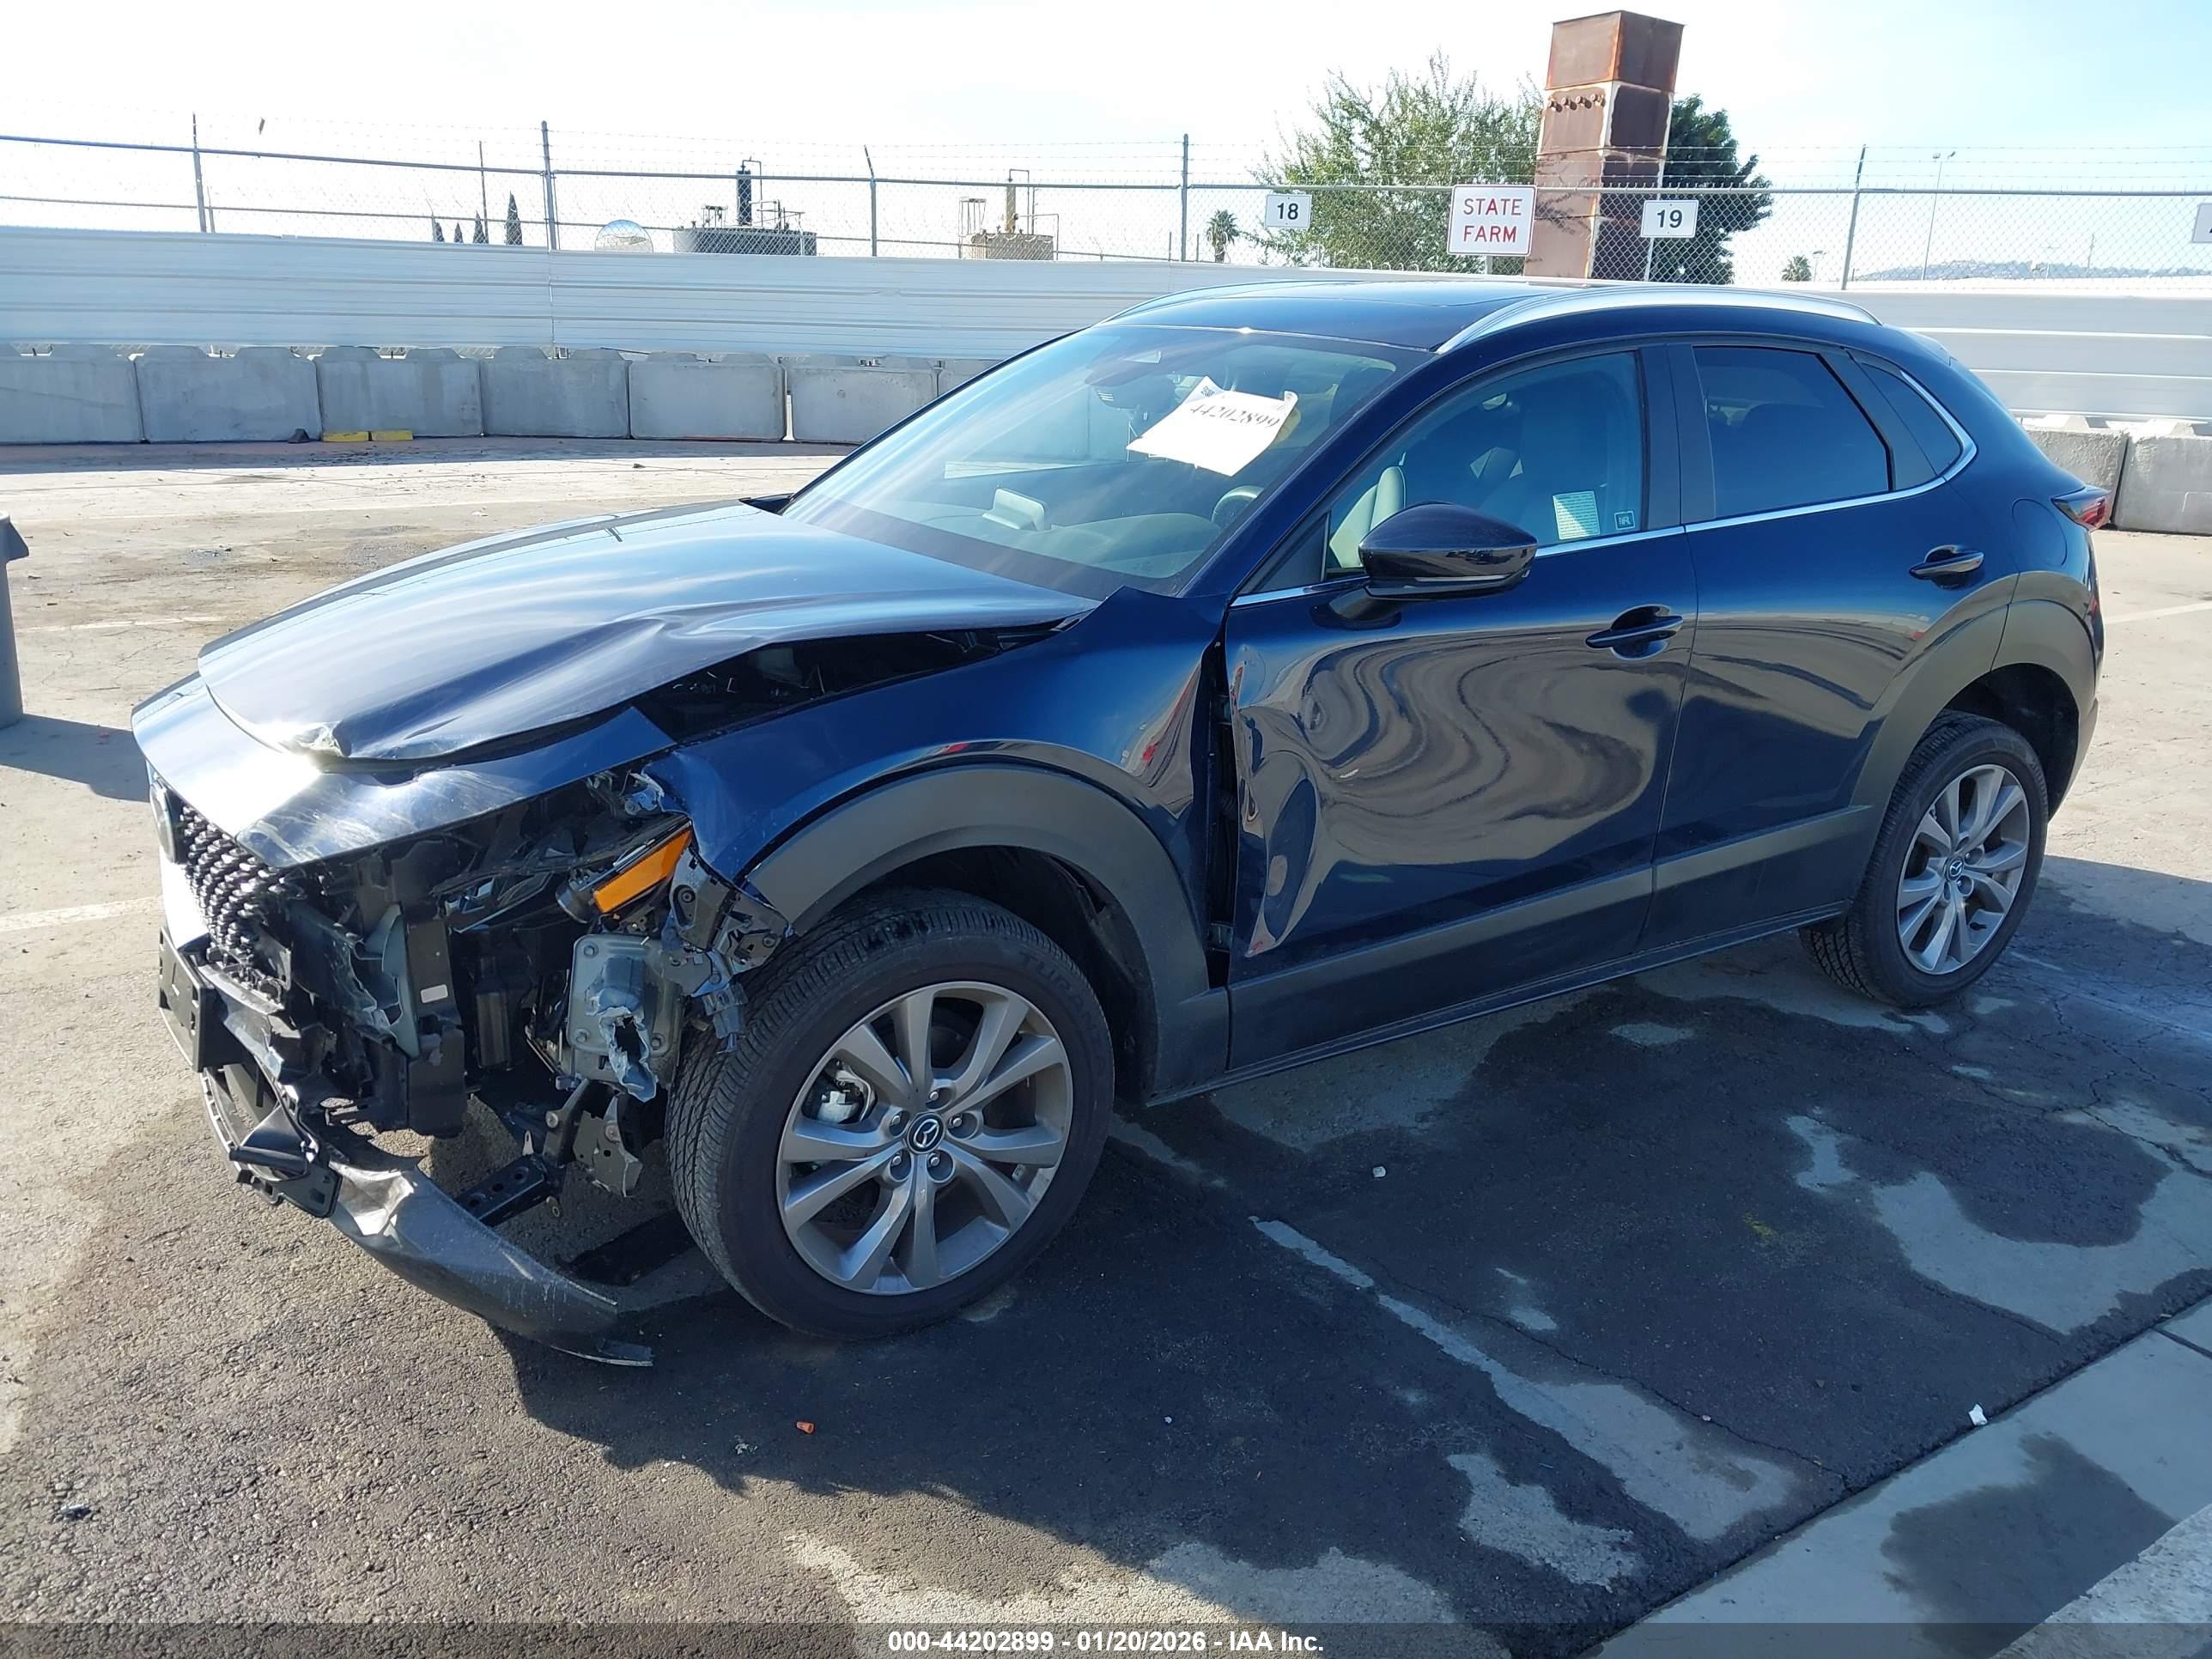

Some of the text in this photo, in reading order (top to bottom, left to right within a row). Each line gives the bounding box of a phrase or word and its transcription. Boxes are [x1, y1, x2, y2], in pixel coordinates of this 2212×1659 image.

[1277, 203, 1299, 221] 18
[1462, 197, 1522, 217] STATE
[1656, 209, 1683, 228] 19
[1462, 224, 1517, 244] FARM
[1189, 404, 1280, 428] 44202899
